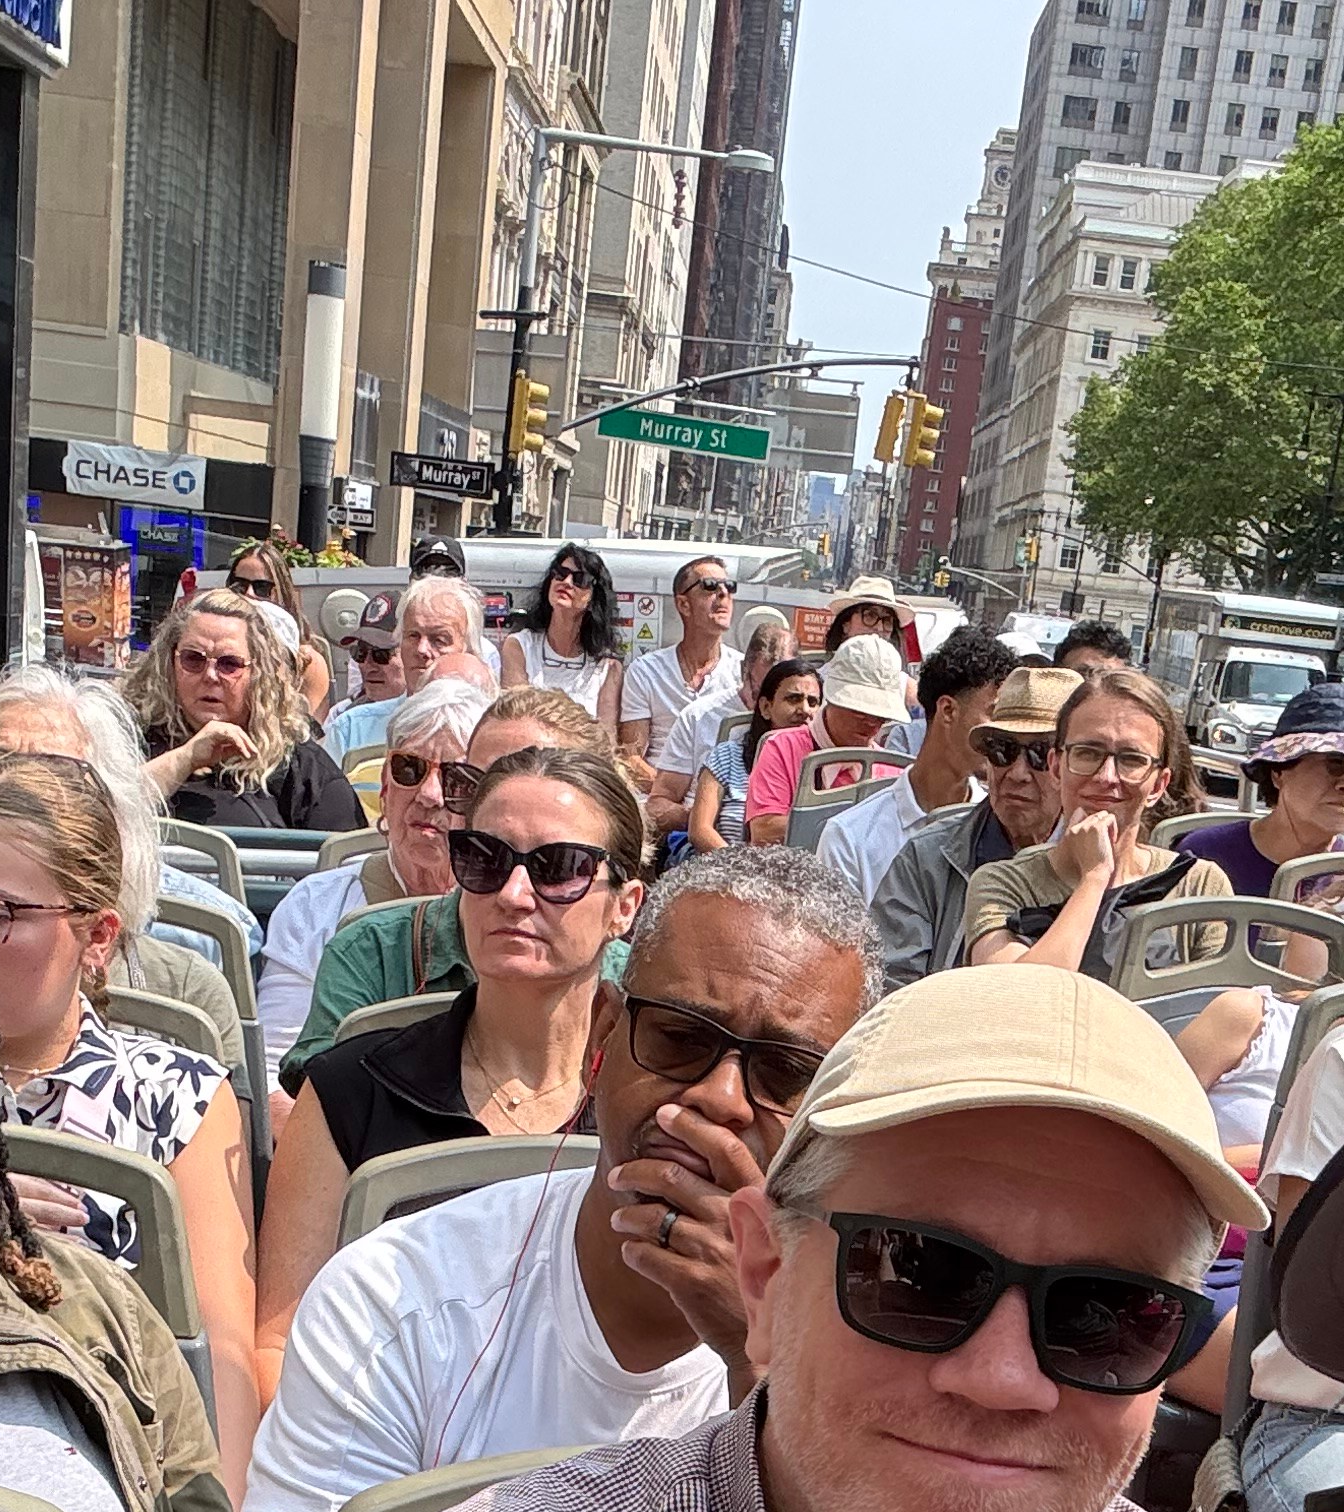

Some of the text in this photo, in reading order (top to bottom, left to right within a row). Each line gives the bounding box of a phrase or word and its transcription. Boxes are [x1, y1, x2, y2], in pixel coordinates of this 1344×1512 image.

[640, 416, 728, 449] Murray St
[75, 459, 168, 489] CHASE
[421, 463, 472, 490] Murray
[140, 528, 179, 543] CHASE
